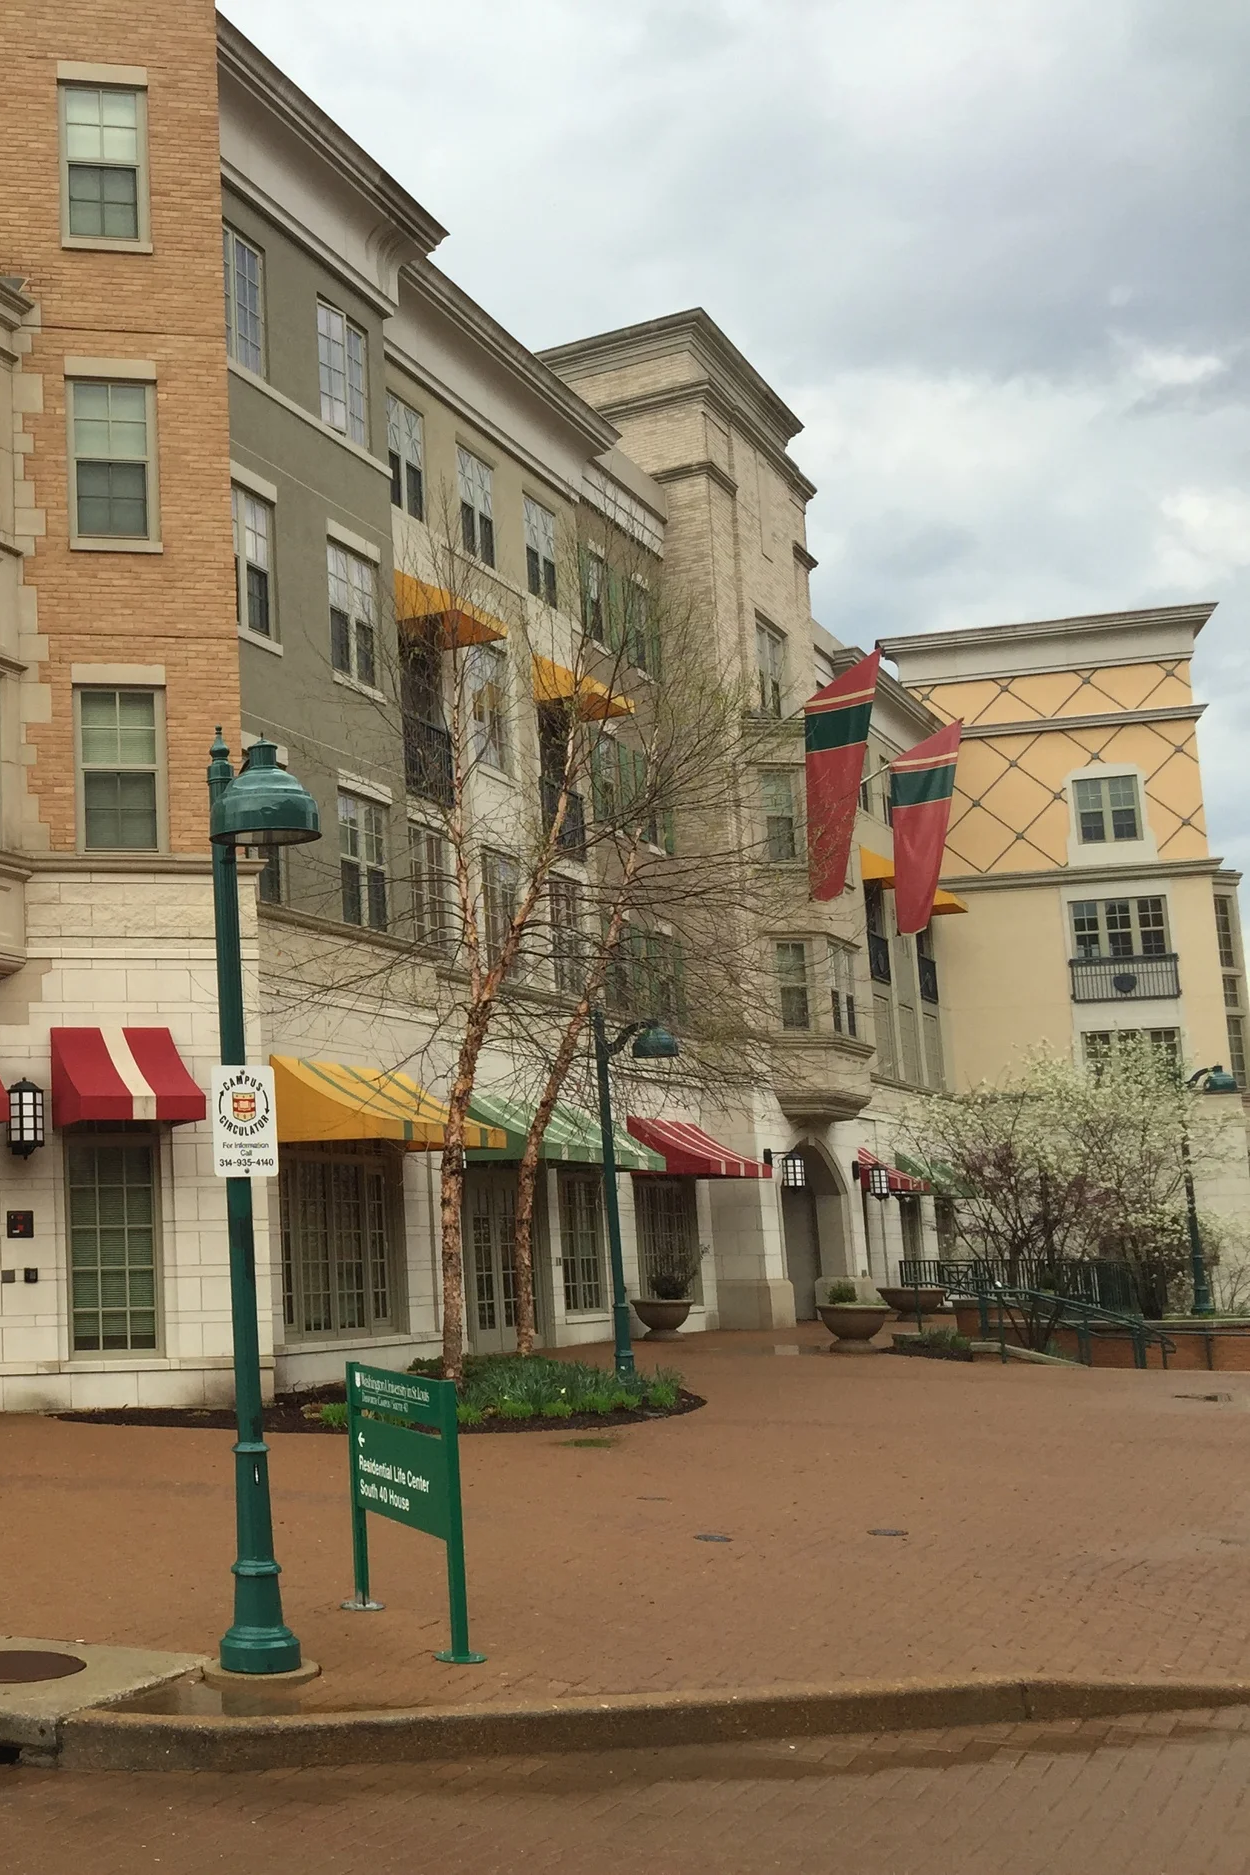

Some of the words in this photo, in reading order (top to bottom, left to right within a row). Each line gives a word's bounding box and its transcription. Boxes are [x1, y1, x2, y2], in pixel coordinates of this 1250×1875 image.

[222, 1075, 263, 1091] CAMPUS
[219, 1114, 269, 1136] CIRCULATOR
[219, 1158, 274, 1167] 314-935-4140
[359, 1454, 393, 1480] Residential
[393, 1465, 406, 1485] Life
[406, 1470, 430, 1493] Center
[360, 1478, 379, 1500] South
[379, 1486, 388, 1503] 40
[388, 1489, 410, 1512] House
